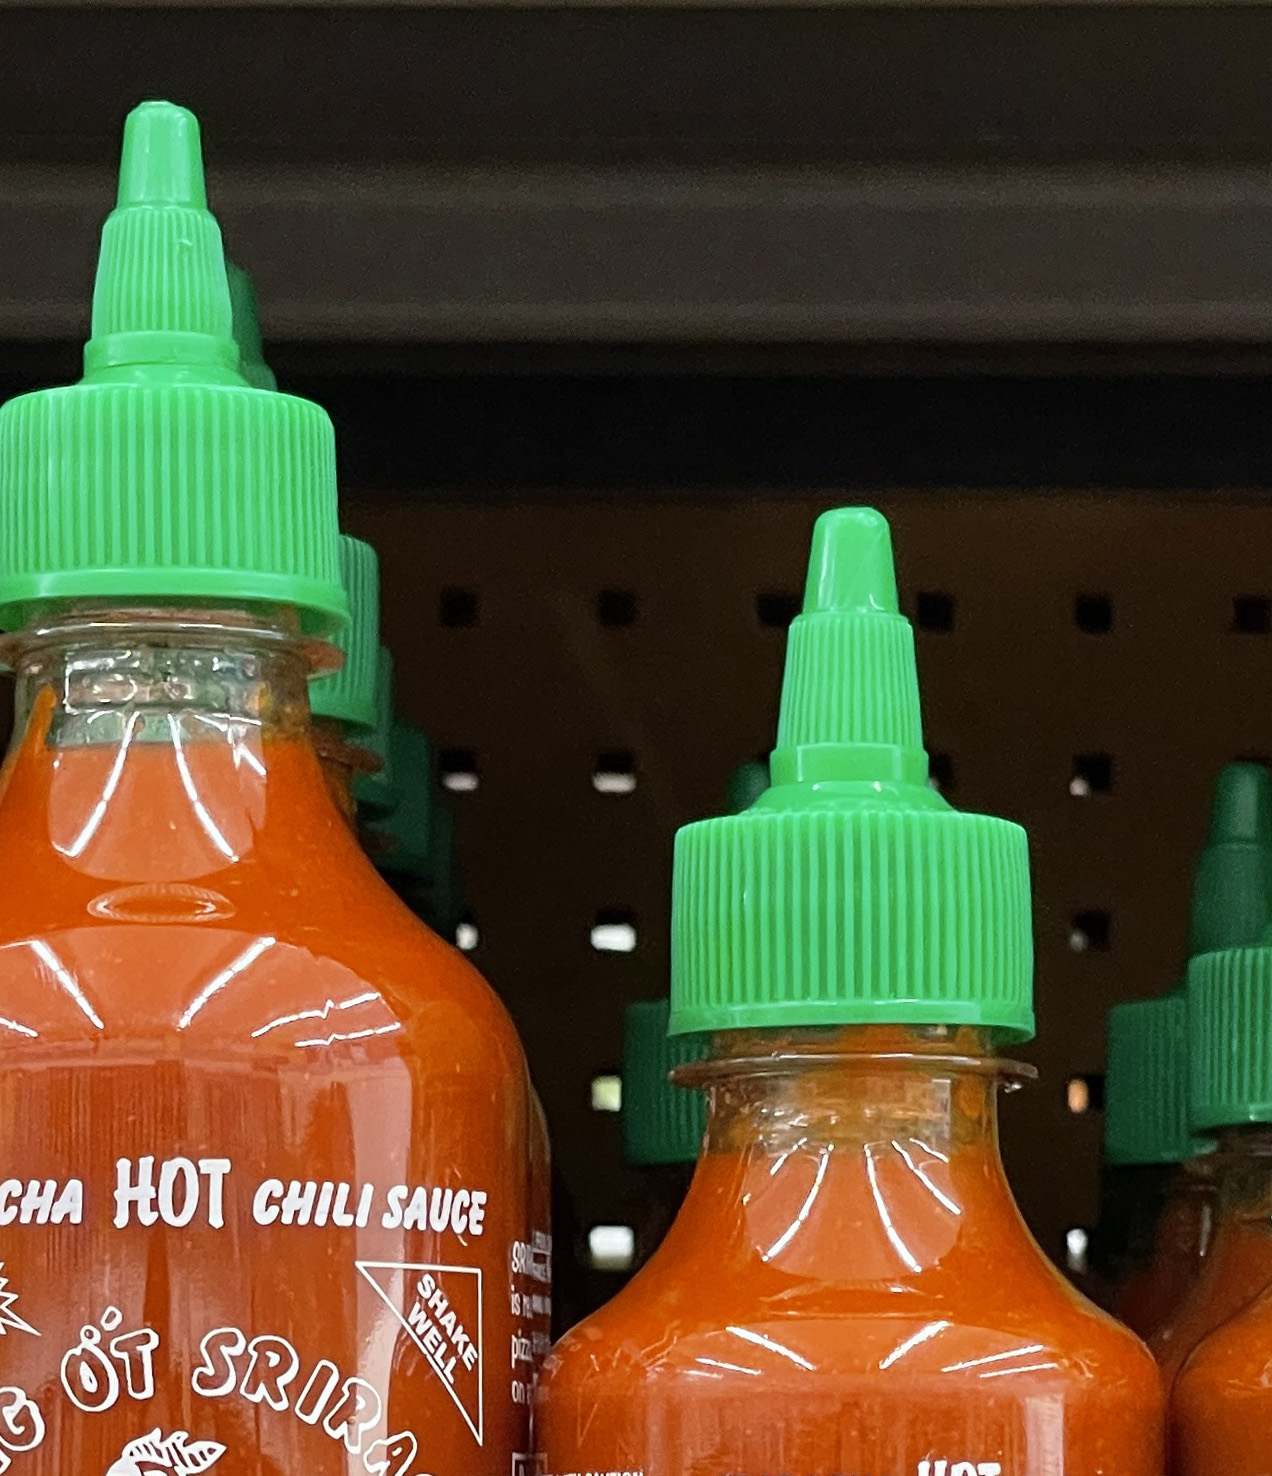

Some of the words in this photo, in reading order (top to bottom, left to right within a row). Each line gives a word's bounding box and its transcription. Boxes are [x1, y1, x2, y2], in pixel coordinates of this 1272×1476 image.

[114, 1156, 232, 1229] HOT
[253, 1180, 377, 1230] CHILI
[383, 1185, 487, 1235] SAUCE
